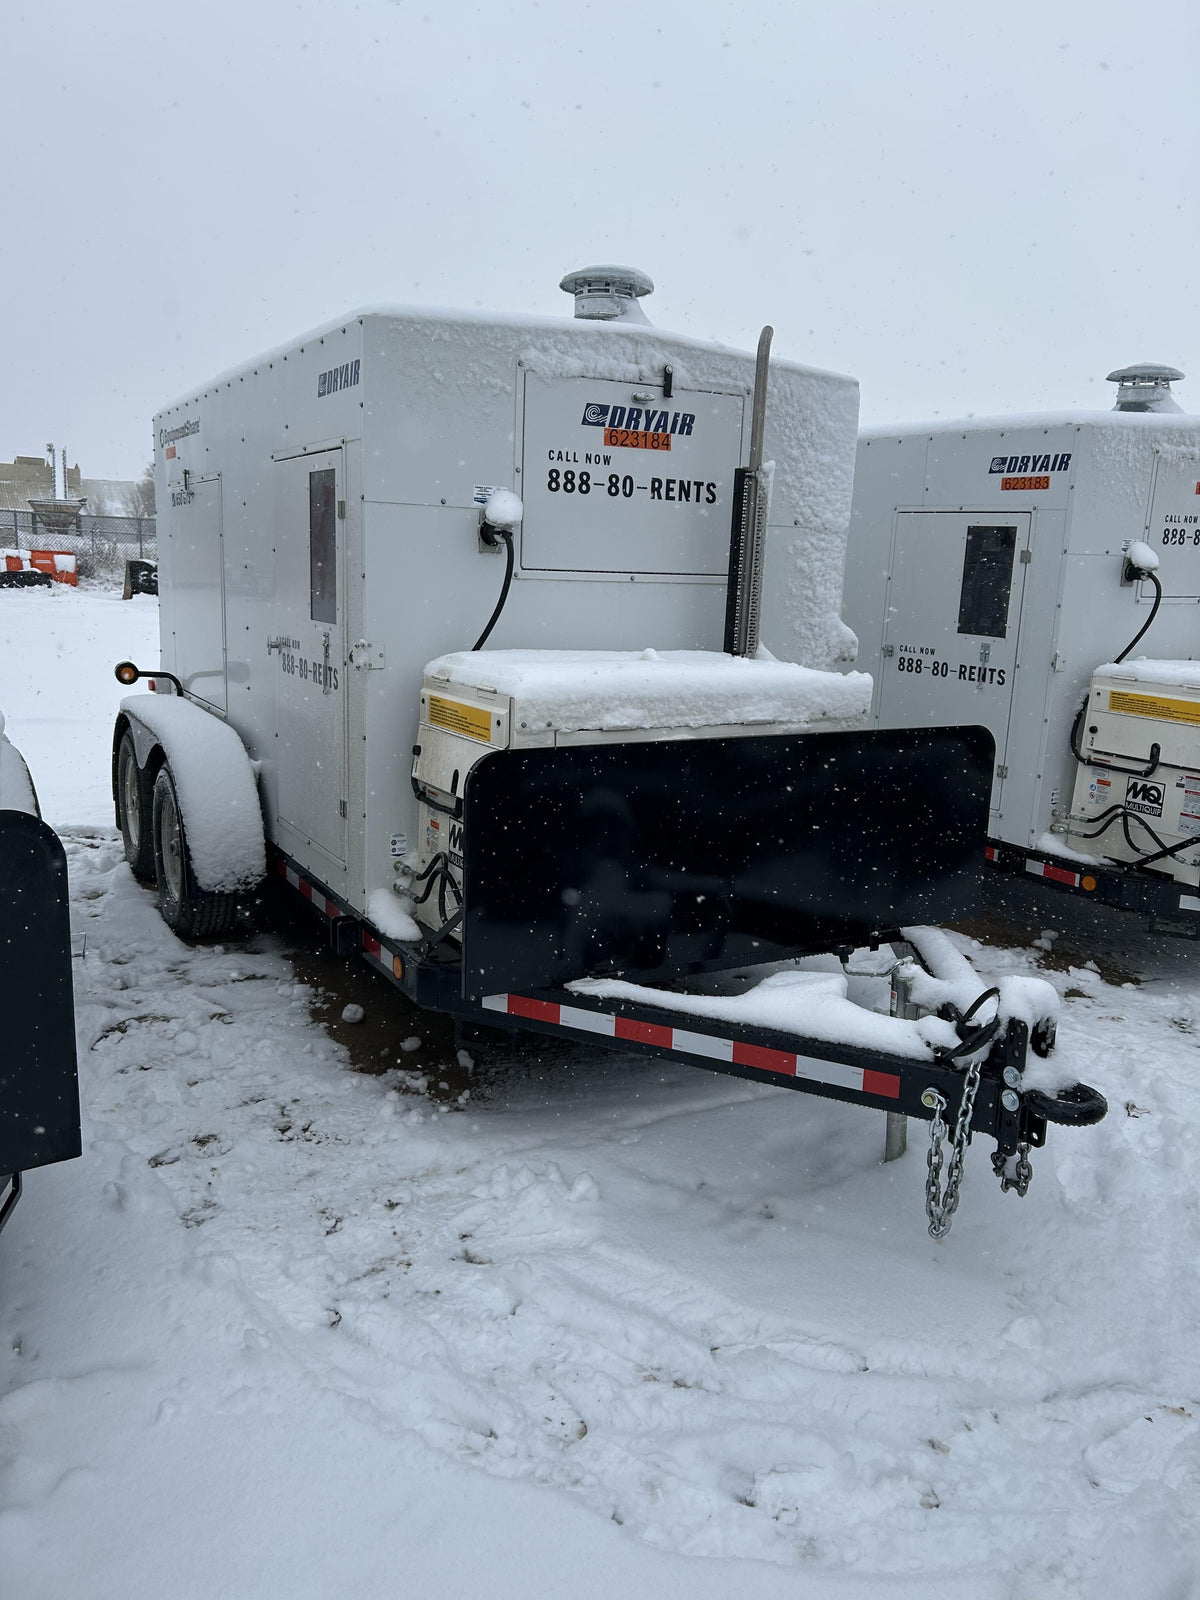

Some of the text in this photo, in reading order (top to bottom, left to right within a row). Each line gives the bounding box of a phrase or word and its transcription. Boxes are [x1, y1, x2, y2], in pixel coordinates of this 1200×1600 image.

[326, 359, 361, 395] DRYAIR
[608, 405, 696, 436] DRYAIR
[608, 429, 671, 451] 623184
[548, 450, 612, 466] CALL NOW
[1006, 453, 1072, 473] DRYAIR
[547, 468, 717, 504] 888-80-RENTS
[1004, 476, 1050, 491] 623183
[1164, 514, 1199, 524] CALL NOW
[899, 644, 936, 656] CALL NOW
[898, 656, 1006, 686] 888-80-RENTS
[1127, 781, 1163, 807] MQ
[1125, 801, 1162, 816] MULTIQUIP
